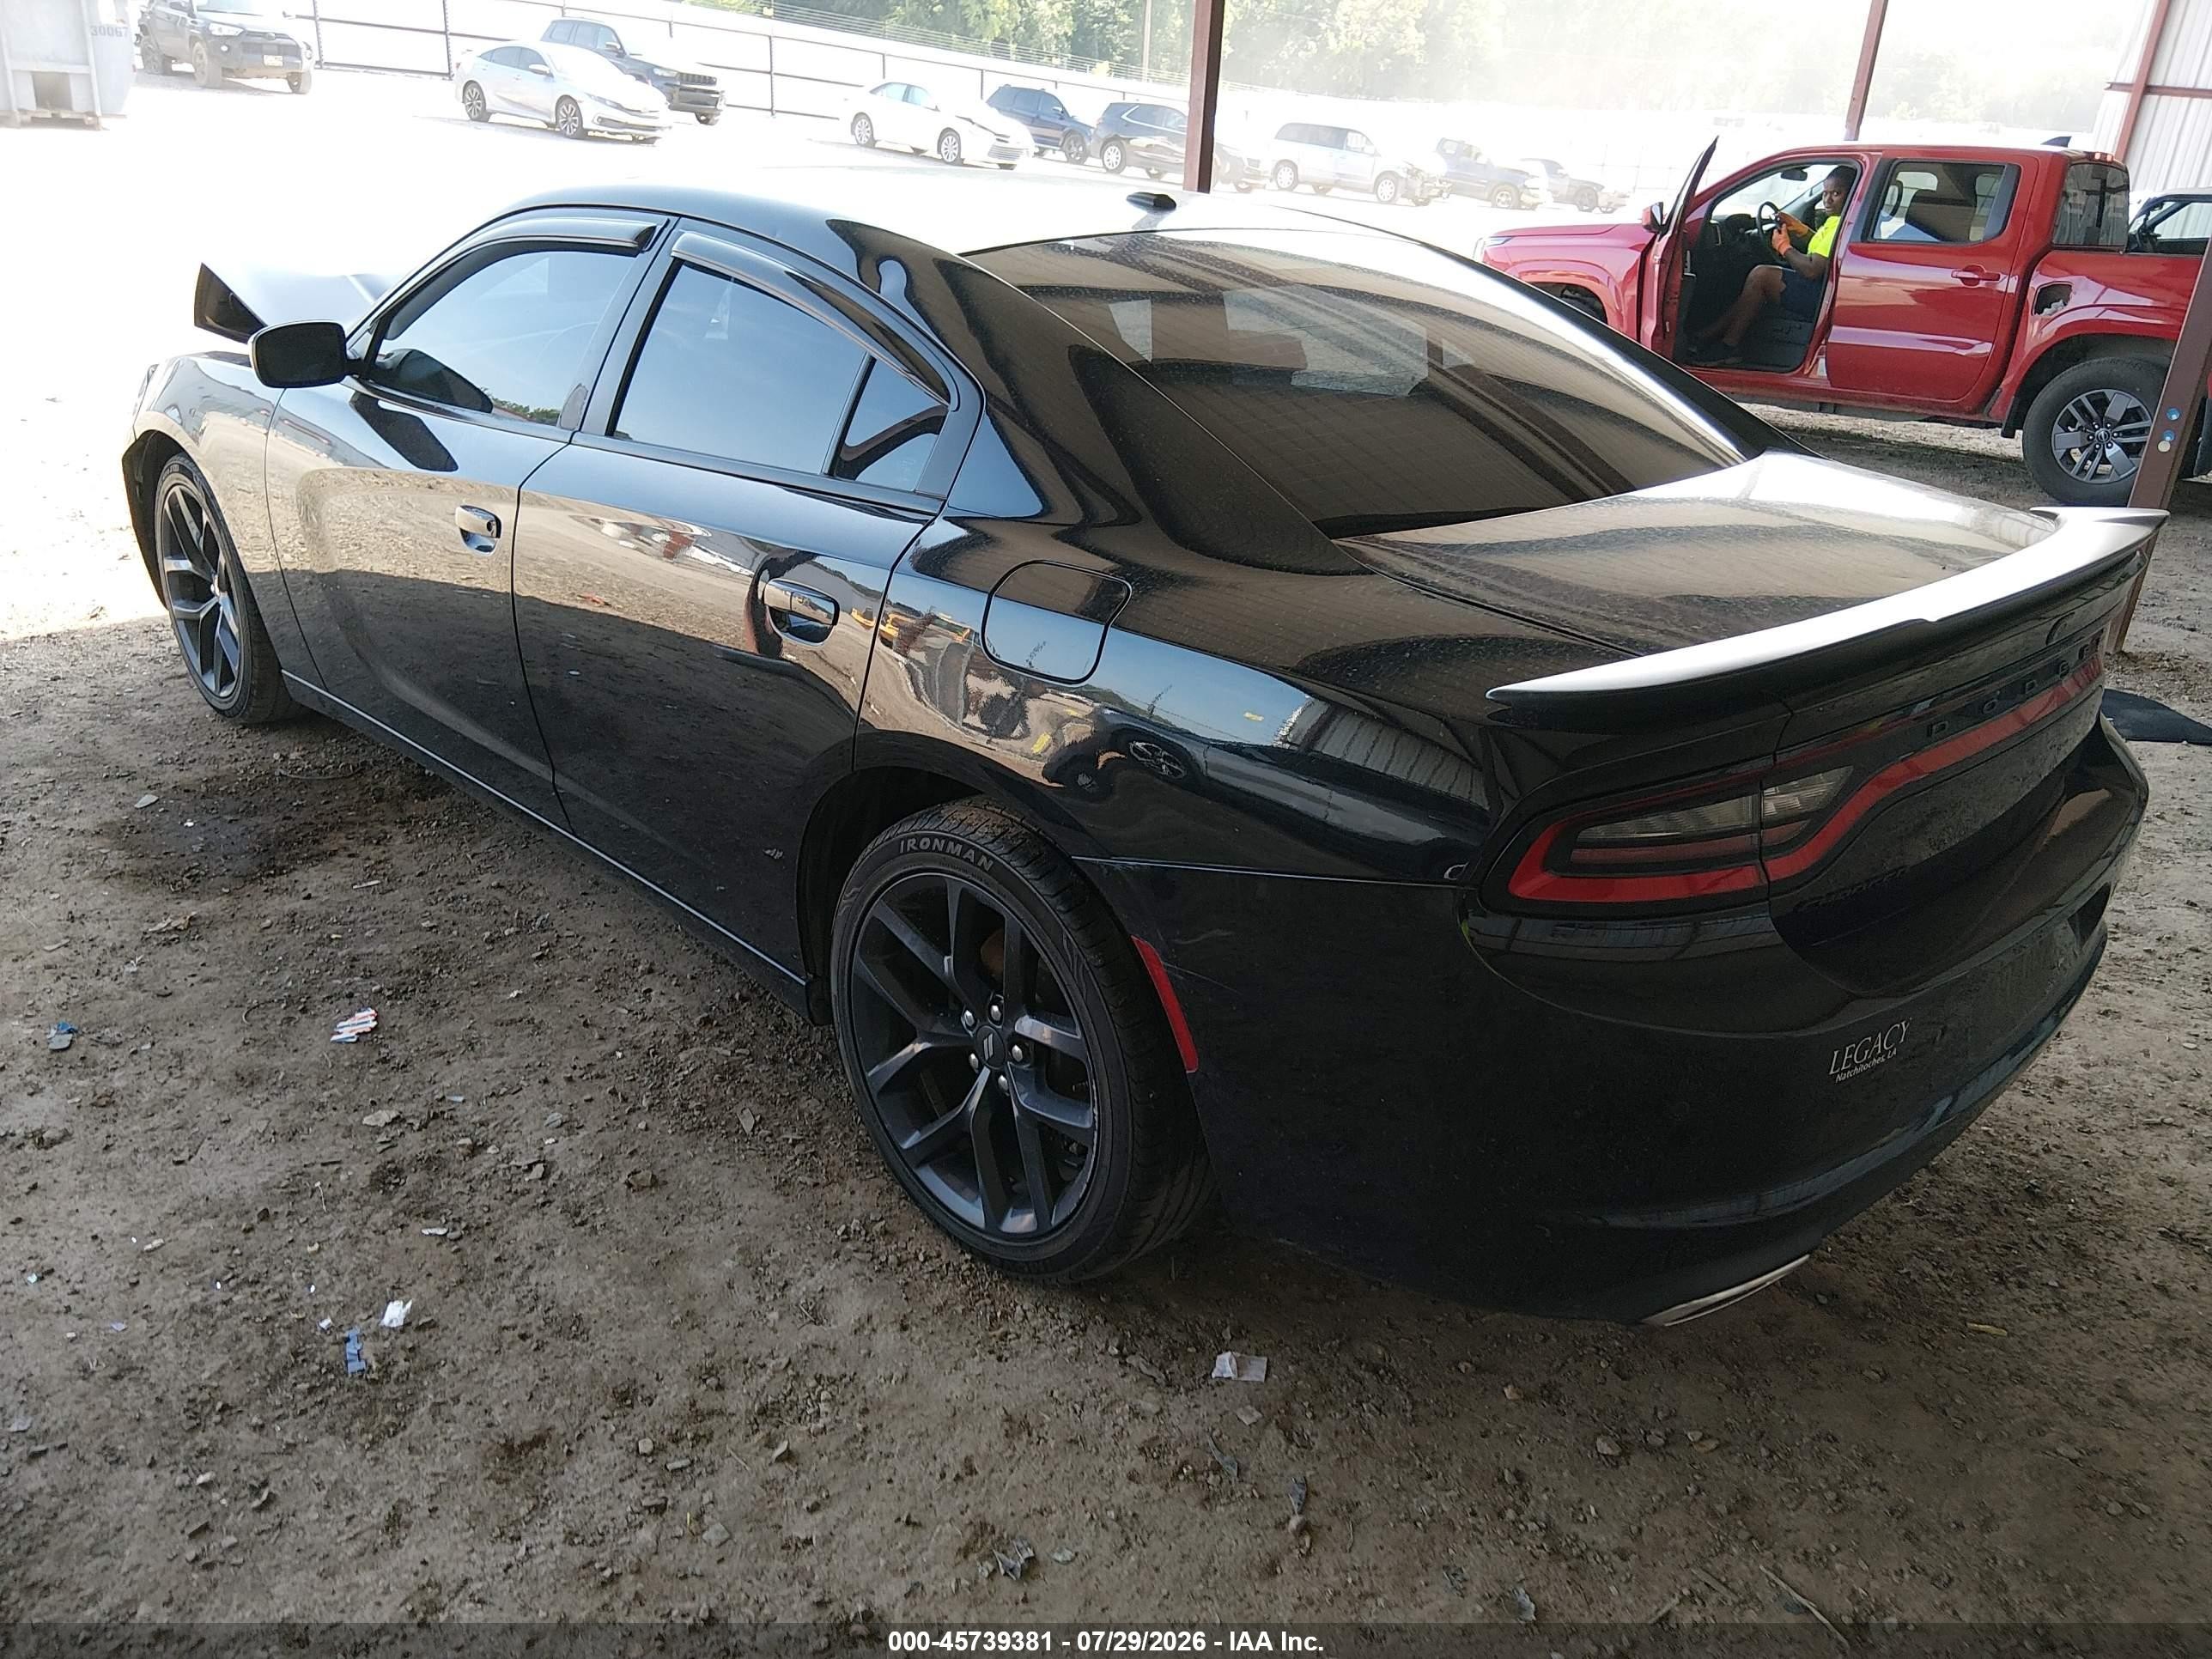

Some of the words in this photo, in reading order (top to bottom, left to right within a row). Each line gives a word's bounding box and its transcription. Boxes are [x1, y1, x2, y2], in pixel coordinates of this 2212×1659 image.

[899, 837, 994, 872] IRONMAN
[1829, 1020, 1910, 1075] LEGACY
[1887, 1048, 1897, 1059] LA
